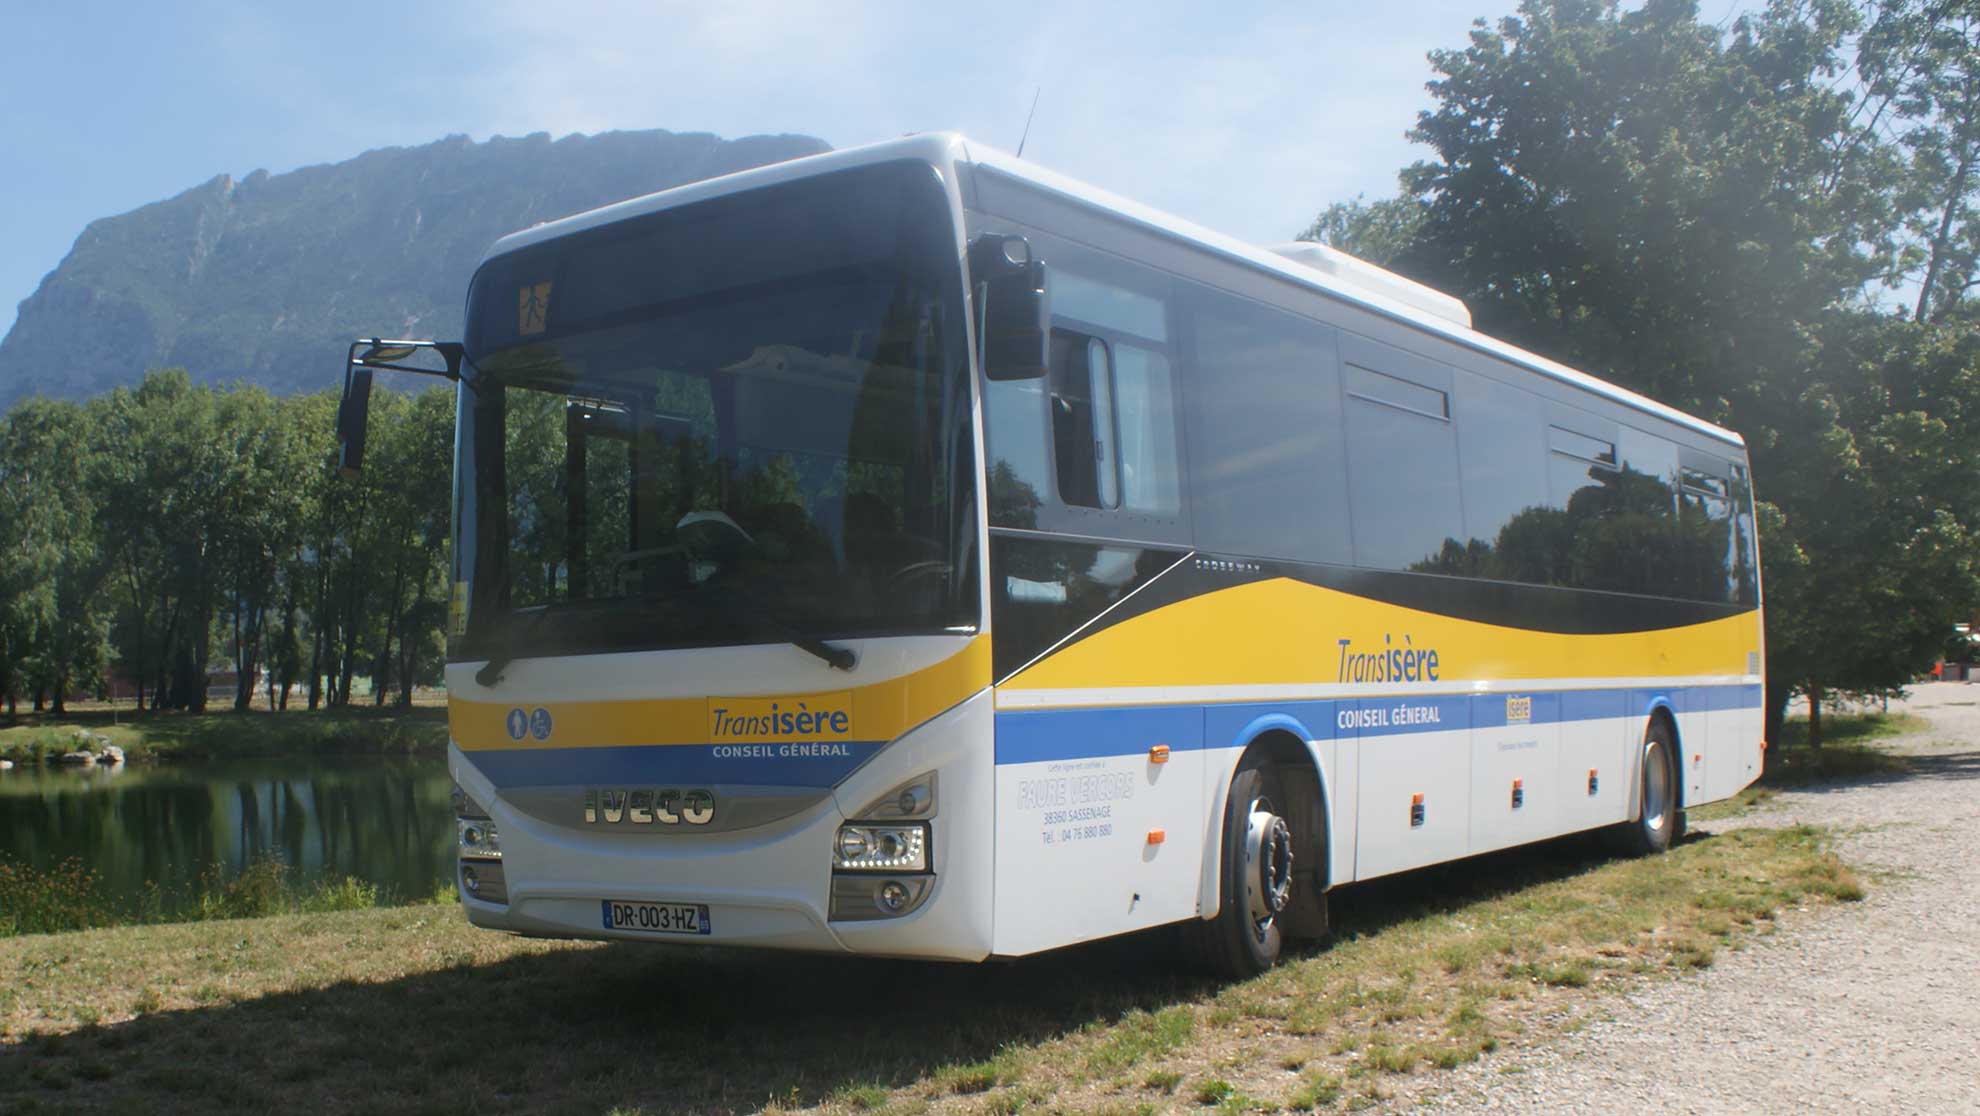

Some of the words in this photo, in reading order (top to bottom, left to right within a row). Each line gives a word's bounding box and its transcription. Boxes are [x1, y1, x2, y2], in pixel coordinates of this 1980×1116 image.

[1337, 633, 1439, 683] Transisère
[713, 702, 849, 736] Transisère
[1337, 708, 1389, 729] CONSEIL
[712, 746, 775, 758] CONSEIL
[779, 742, 850, 757] GÉNÉRAL
[1017, 778, 1066, 811] FAURE
[1070, 770, 1136, 806] VERCORS
[585, 789, 715, 825] IVECO
[1068, 805, 1112, 822] SASSENAGE
[1062, 829, 1072, 842] 04
